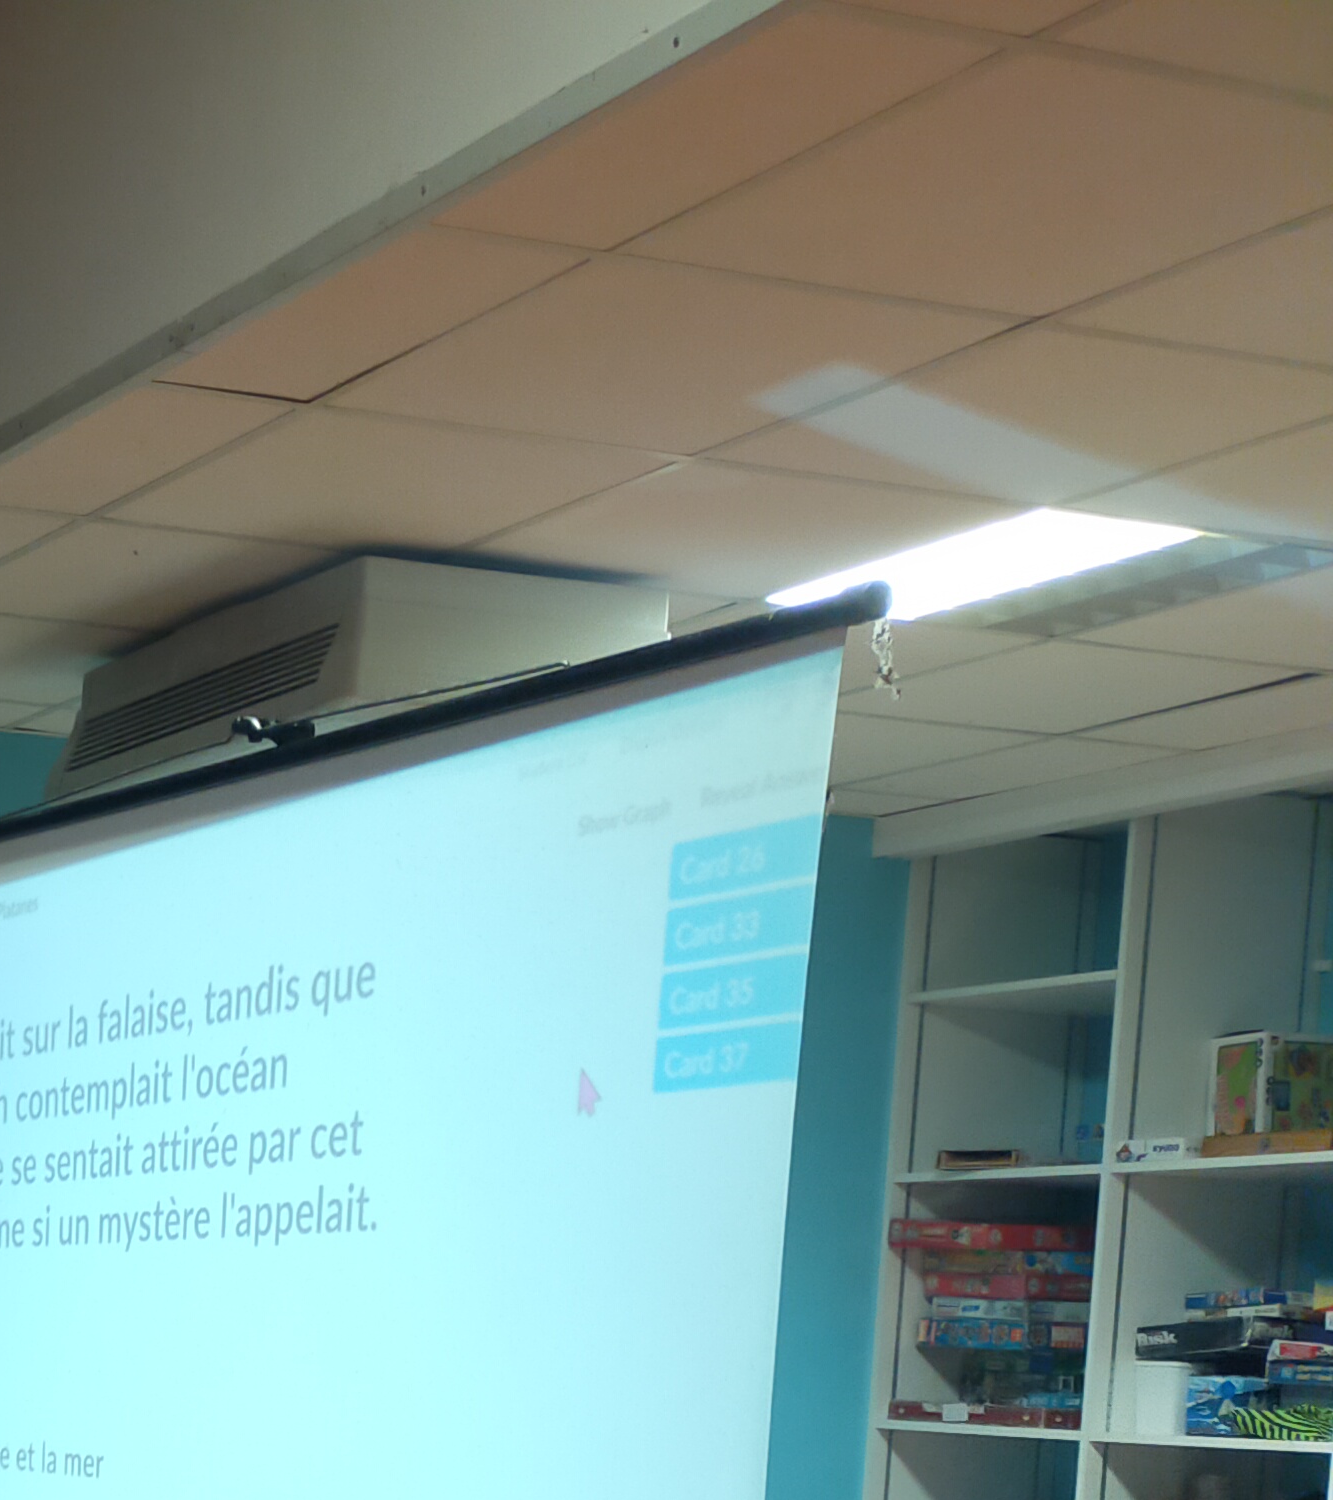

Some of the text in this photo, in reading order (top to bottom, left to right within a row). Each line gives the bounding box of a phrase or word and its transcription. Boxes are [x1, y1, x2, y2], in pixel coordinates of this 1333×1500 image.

[680, 850, 730, 885] Card
[676, 916, 725, 950] Card
[23, 1018, 60, 1055] sur
[68, 1005, 88, 1049] la
[98, 989, 194, 1042] falaise,
[205, 964, 300, 1026] tandis
[311, 961, 376, 1016] que
[669, 980, 721, 1015] Card
[663, 1043, 749, 1079] Card 37
[16, 1060, 172, 1121] contemplait
[182, 1046, 288, 1103] l'océan
[11, 1152, 37, 1184] se
[45, 1133, 132, 1183] sentait
[141, 1121, 238, 1176] attirée
[248, 1121, 302, 1173] par
[310, 1109, 363, 1160] cet
[32, 1206, 50, 1247] si
[59, 1210, 89, 1246] un
[98, 1196, 210, 1252] mystère
[221, 1183, 378, 1247] l'appelait.
[16, 1444, 35, 1472] et
[41, 1440, 57, 1474] la
[64, 1449, 104, 1478] mer
